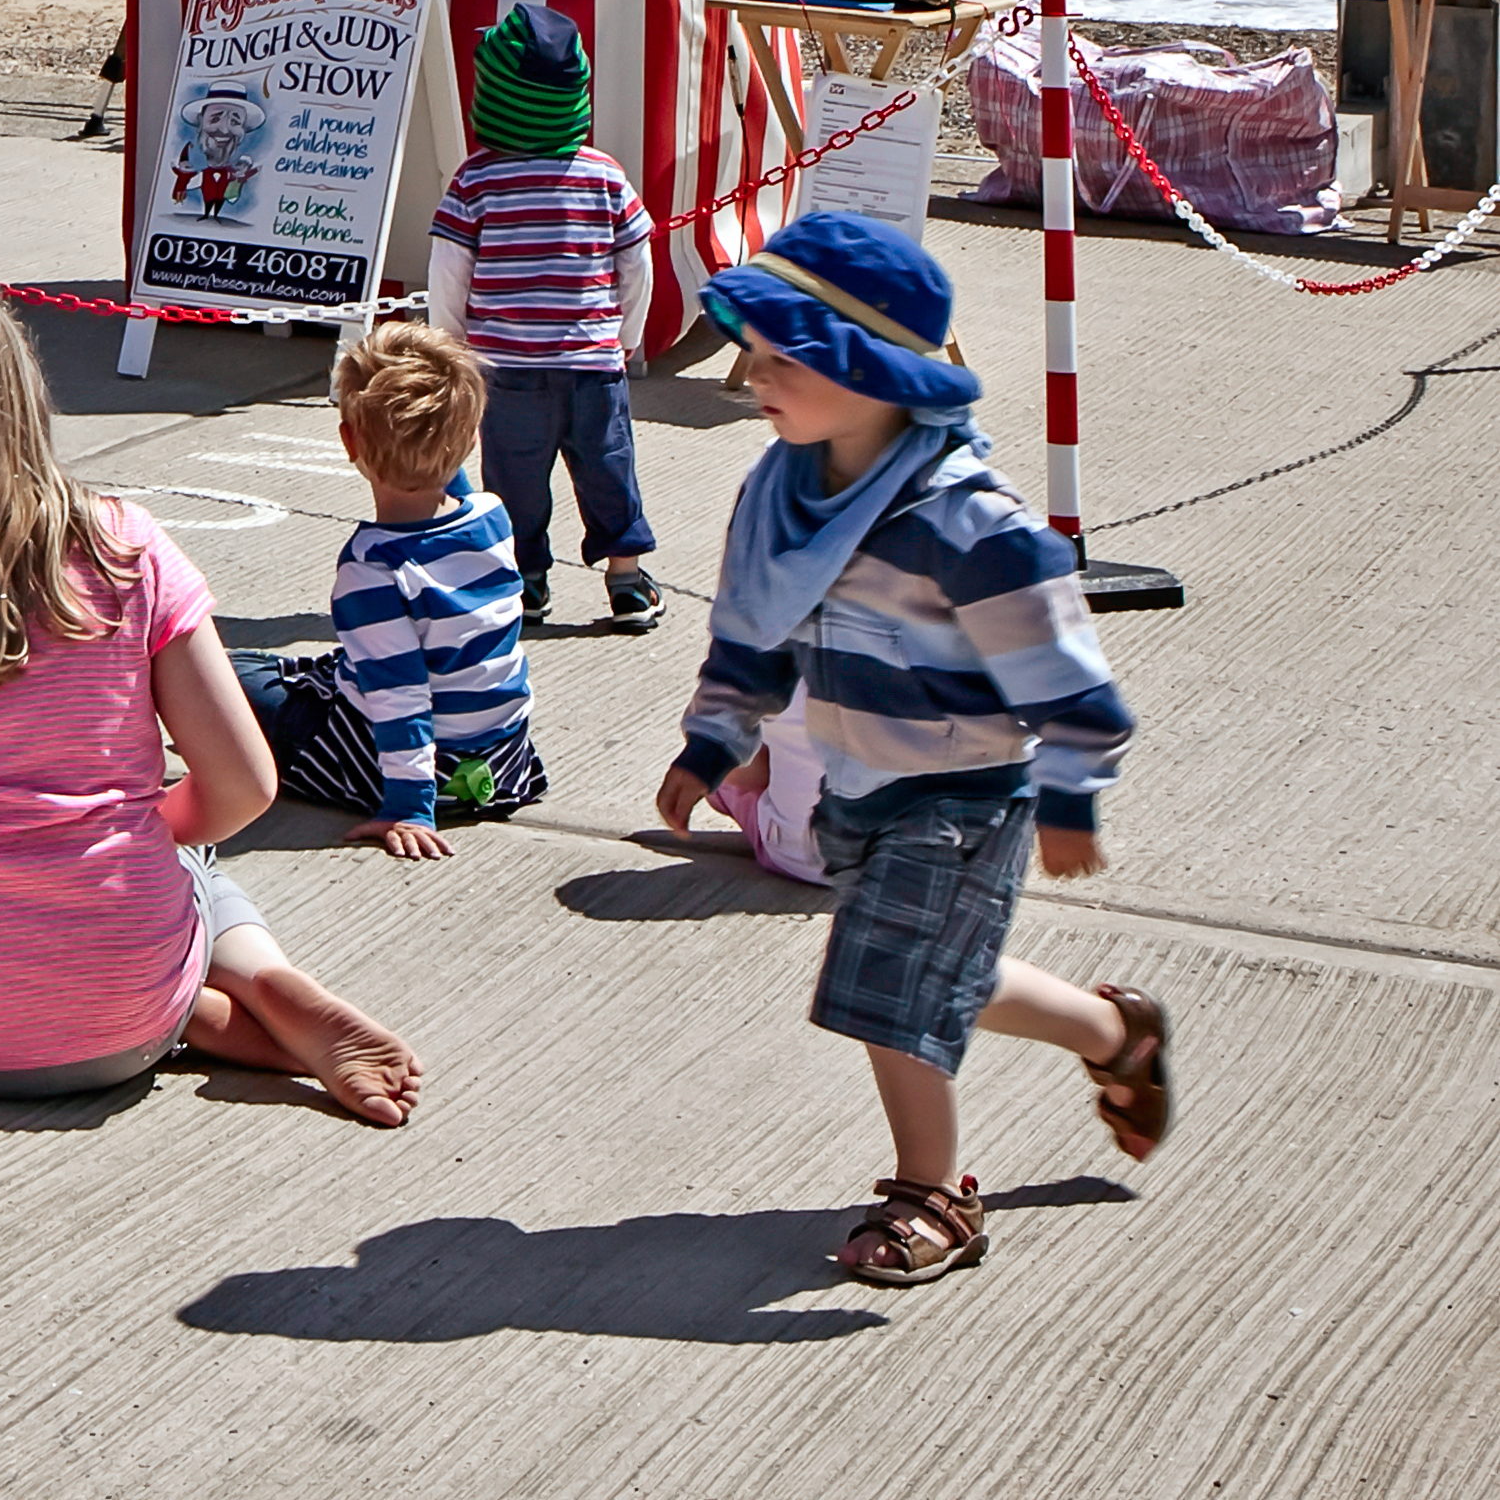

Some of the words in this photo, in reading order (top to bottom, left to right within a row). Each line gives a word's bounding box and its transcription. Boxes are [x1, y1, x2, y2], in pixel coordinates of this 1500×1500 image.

[185, 22, 293, 68] PUNCH
[296, 21, 357, 62] &
[324, 16, 412, 61] JUDY
[279, 61, 393, 100] SHOW
[288, 108, 311, 129] all
[319, 116, 376, 136] round
[274, 156, 375, 181] entertainer
[278, 194, 299, 214] to
[153, 237, 237, 270] 01394
[246, 249, 360, 284] 460871
